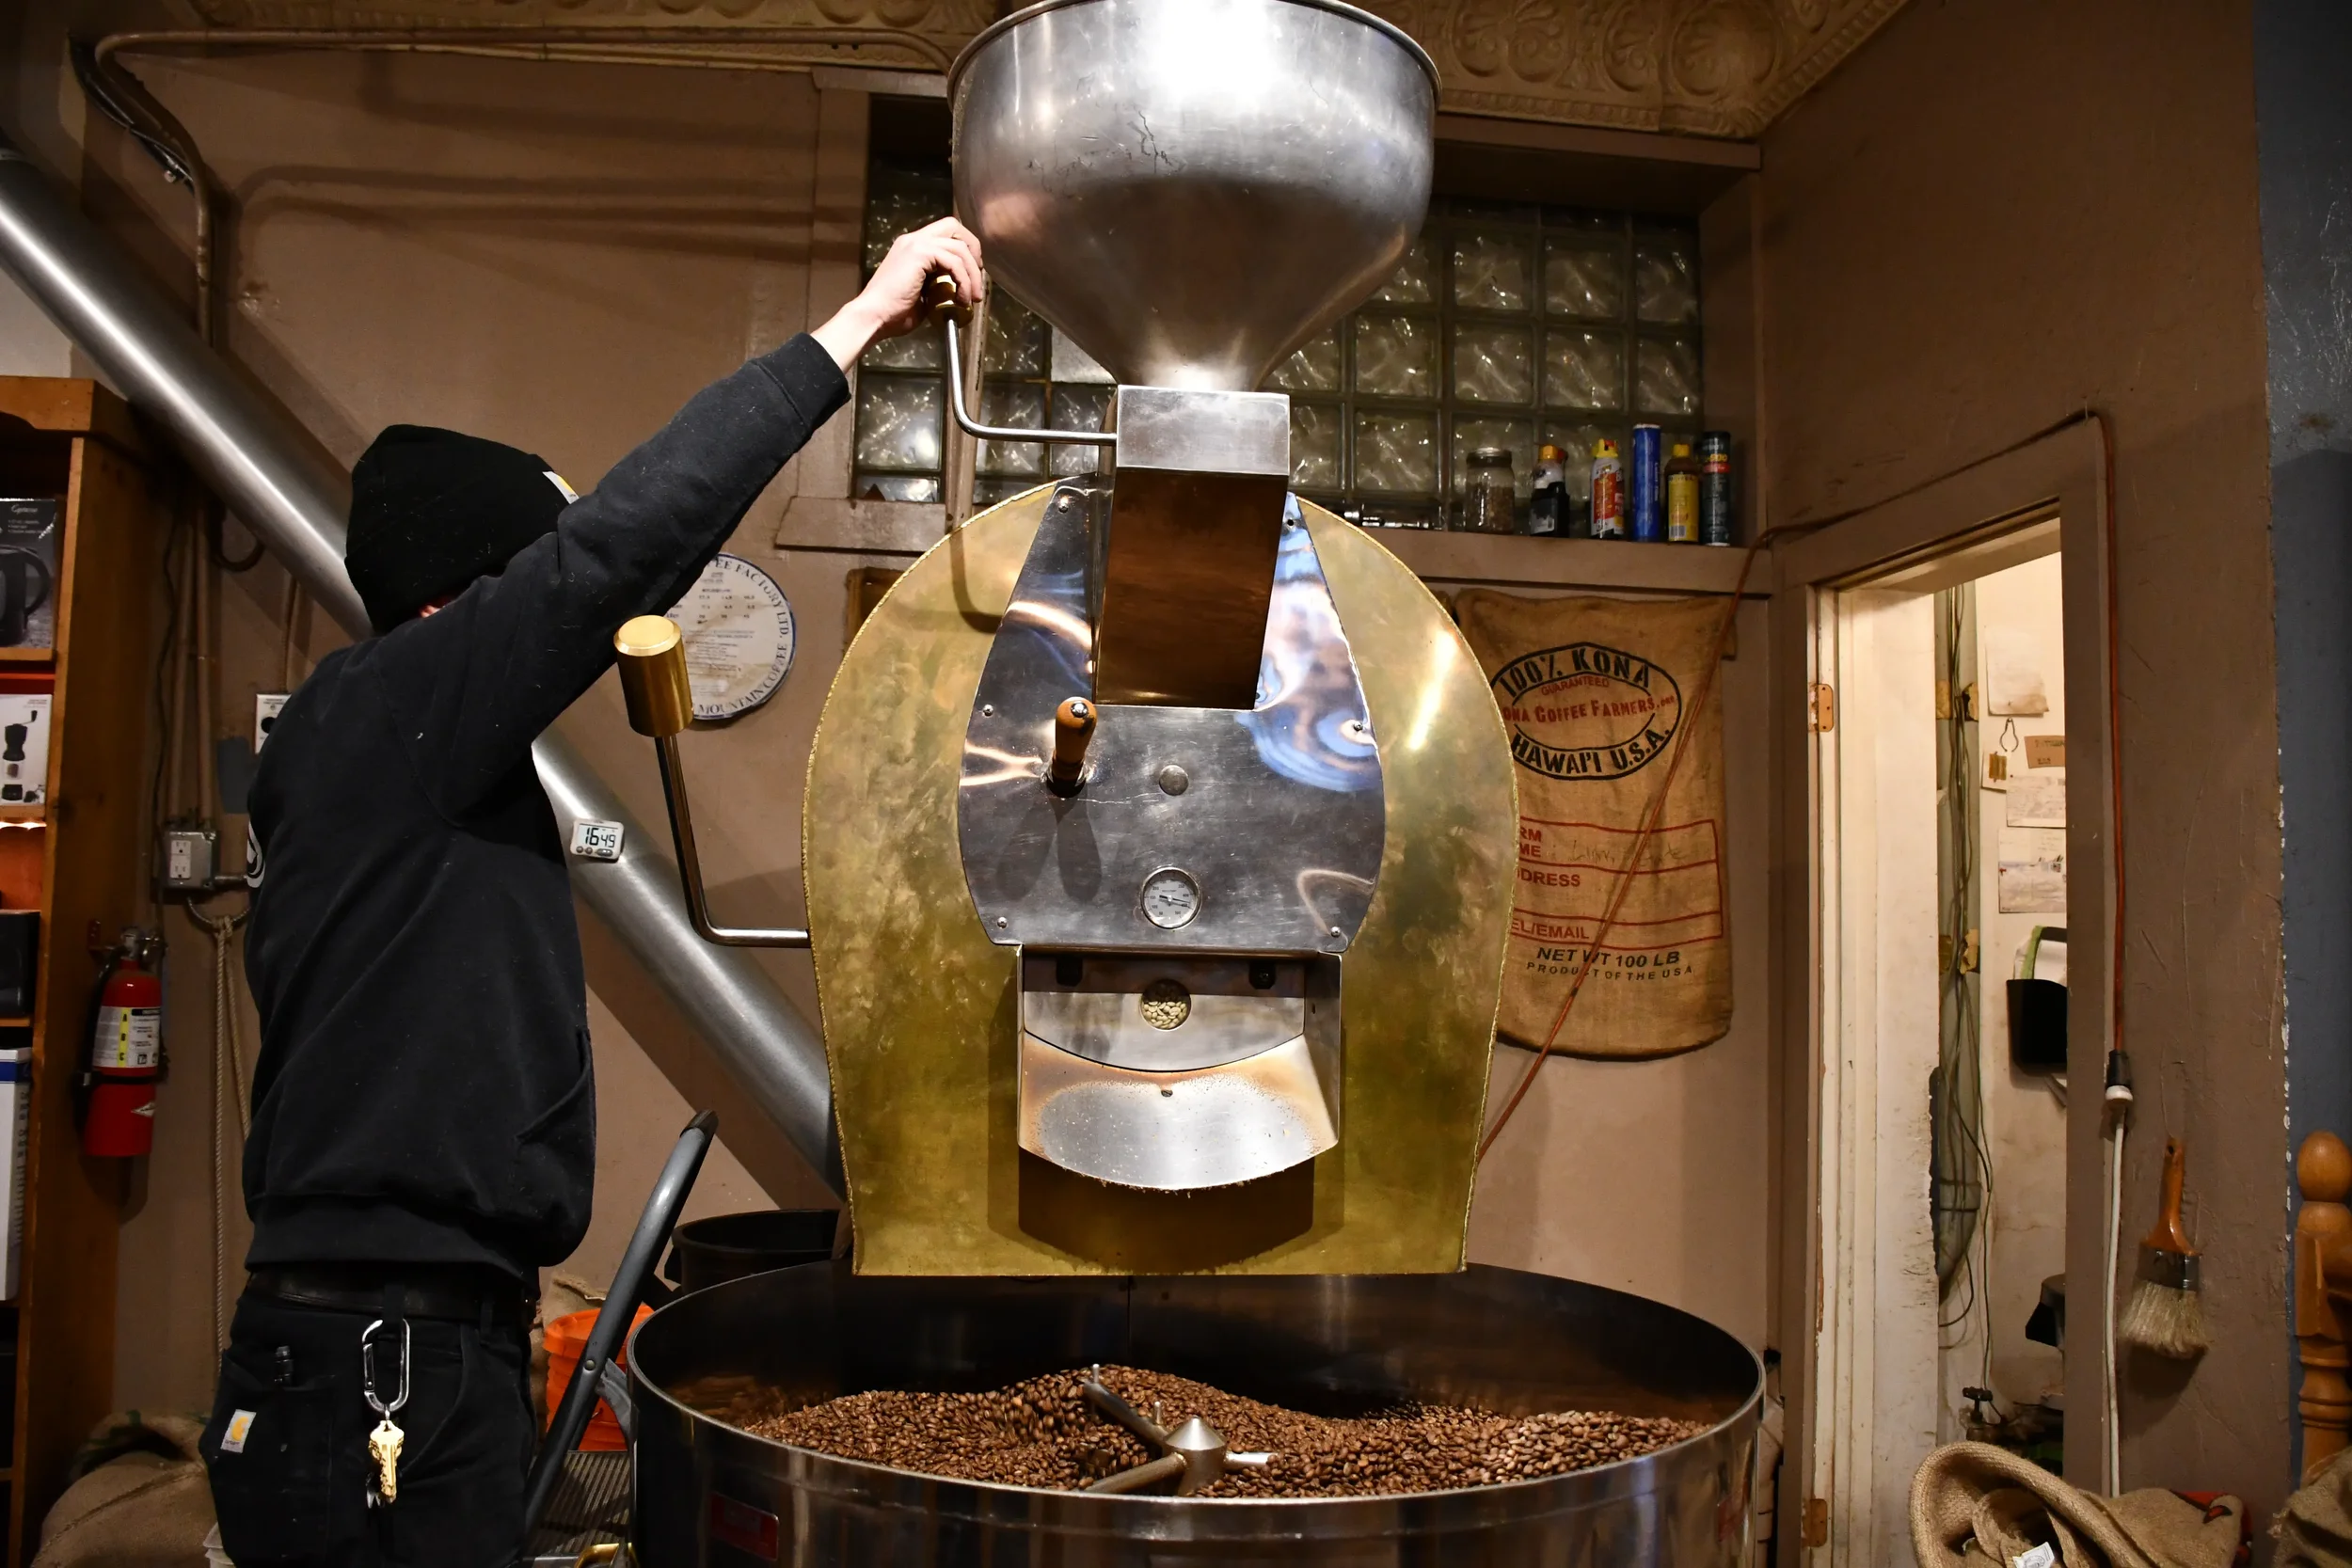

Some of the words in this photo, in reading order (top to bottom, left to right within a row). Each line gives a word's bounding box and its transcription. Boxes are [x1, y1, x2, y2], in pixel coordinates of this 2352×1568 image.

[736, 563, 783, 608] FACTORY
[776, 611, 789, 639] LTD.
[1499, 654, 1564, 698] 100%
[1571, 648, 1649, 689] KONA
[1541, 675, 1610, 696] GUARANTEED
[698, 687, 765, 715] MOUNTAIN
[1502, 705, 1531, 722] ONA
[1534, 703, 1587, 722] COFFEE
[1610, 729, 1670, 770] U.S.A.
[1520, 827, 1541, 843] RM
[1519, 843, 1541, 858] ME
[1512, 918, 1590, 940] EL/EMAIL
[1536, 947, 1578, 962] NET
[1615, 954, 1647, 968] 100
[1653, 951, 1680, 967] LB
[1526, 961, 1599, 977] PRODUT
[1604, 971, 1621, 980] OF
[1627, 972, 1656, 981] THE
[1661, 965, 1692, 978] USA
